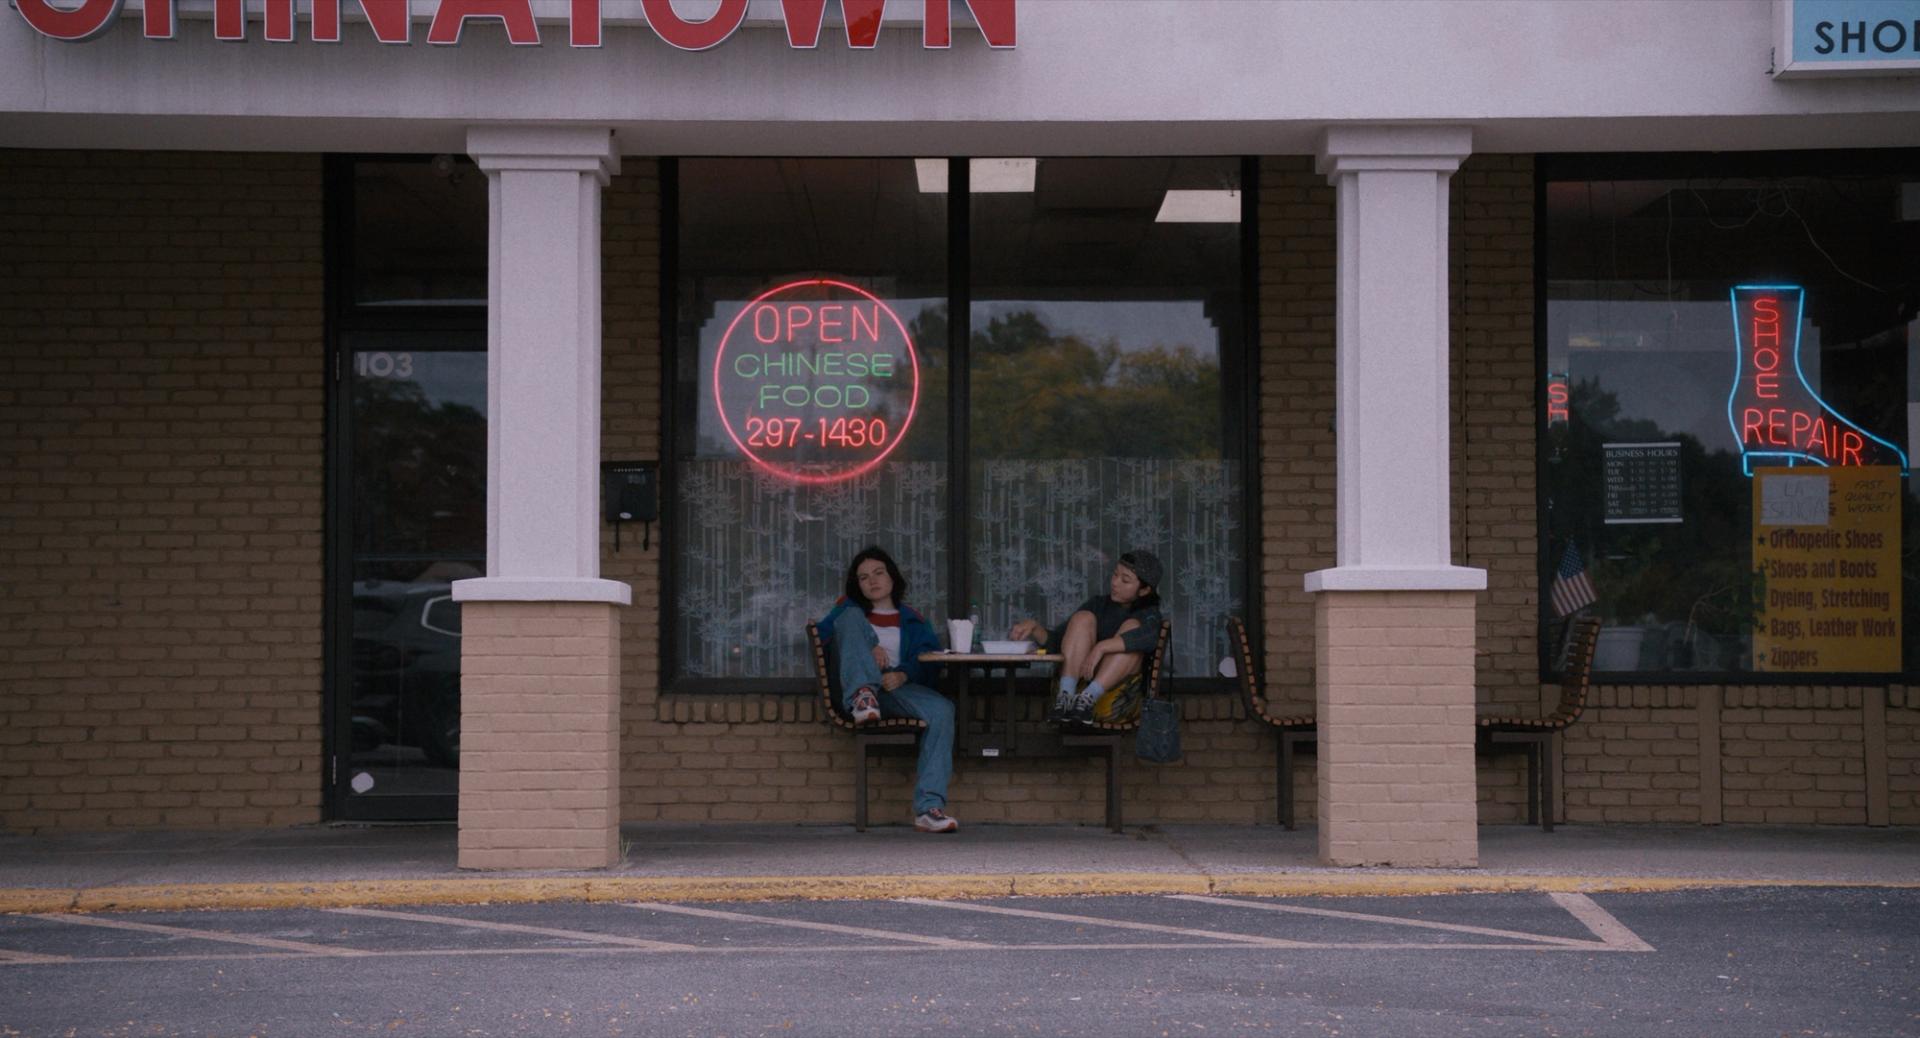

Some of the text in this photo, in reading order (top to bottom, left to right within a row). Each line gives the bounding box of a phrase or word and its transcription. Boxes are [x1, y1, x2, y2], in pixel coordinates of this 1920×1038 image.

[1814, 20, 1920, 54] SHO
[754, 303, 880, 344] OPEN
[1753, 297, 1779, 399] SHOE
[356, 351, 414, 377] 103
[734, 352, 894, 378] CHINESE
[759, 385, 870, 409] FOOD
[746, 416, 887, 448] 297-1430
[1743, 408, 1864, 467] REPAIR
[1606, 447, 1678, 458] BUSINESS HOURS
[1770, 529, 1883, 552] Orthopedic Shoes
[1771, 559, 1877, 579] Shoes and Boots
[1771, 588, 1890, 611] Dyeing, Stretching
[1771, 618, 1896, 640] Bags, Leather Work
[1770, 647, 1819, 669] Zippers
